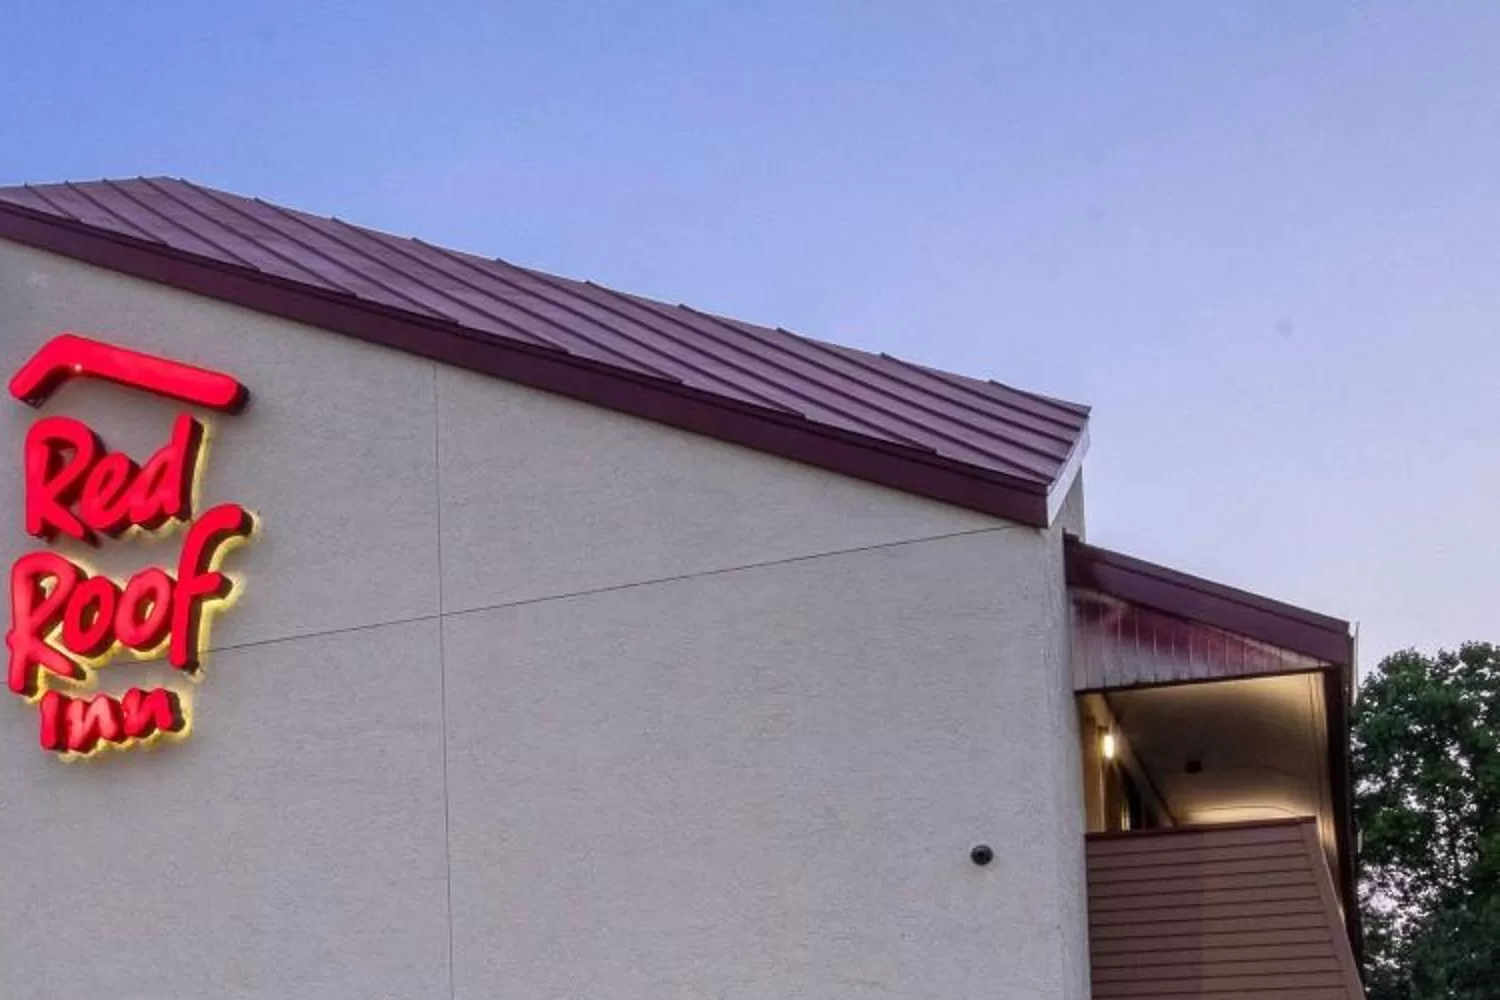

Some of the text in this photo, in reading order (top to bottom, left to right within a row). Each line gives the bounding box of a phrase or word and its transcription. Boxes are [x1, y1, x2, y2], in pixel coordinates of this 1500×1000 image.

[24, 412, 201, 544] Red
[6, 503, 252, 696] Roof
[40, 687, 185, 753] Inn
